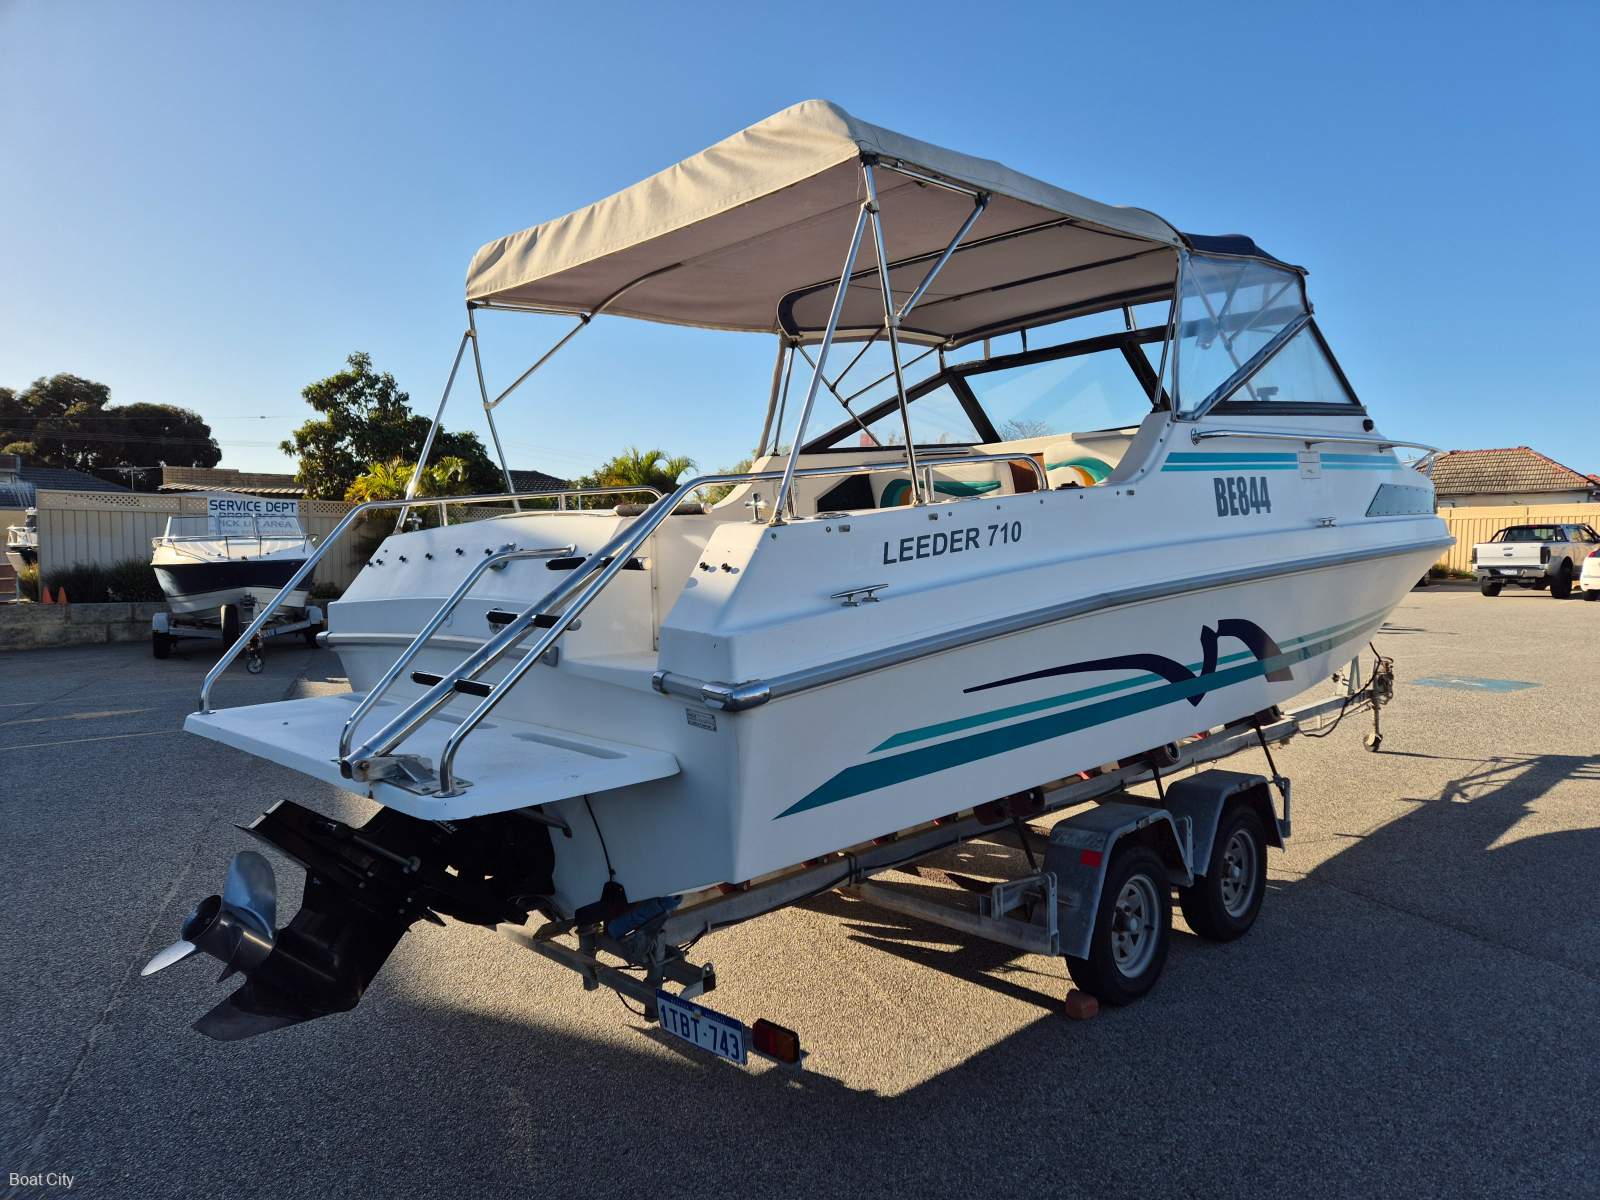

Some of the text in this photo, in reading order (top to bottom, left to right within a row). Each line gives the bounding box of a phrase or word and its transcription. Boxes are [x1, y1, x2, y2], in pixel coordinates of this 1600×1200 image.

[209, 500, 297, 513] SERVICE DEPT
[1213, 476, 1271, 517] BE844
[884, 521, 1022, 565] LEEDER 710
